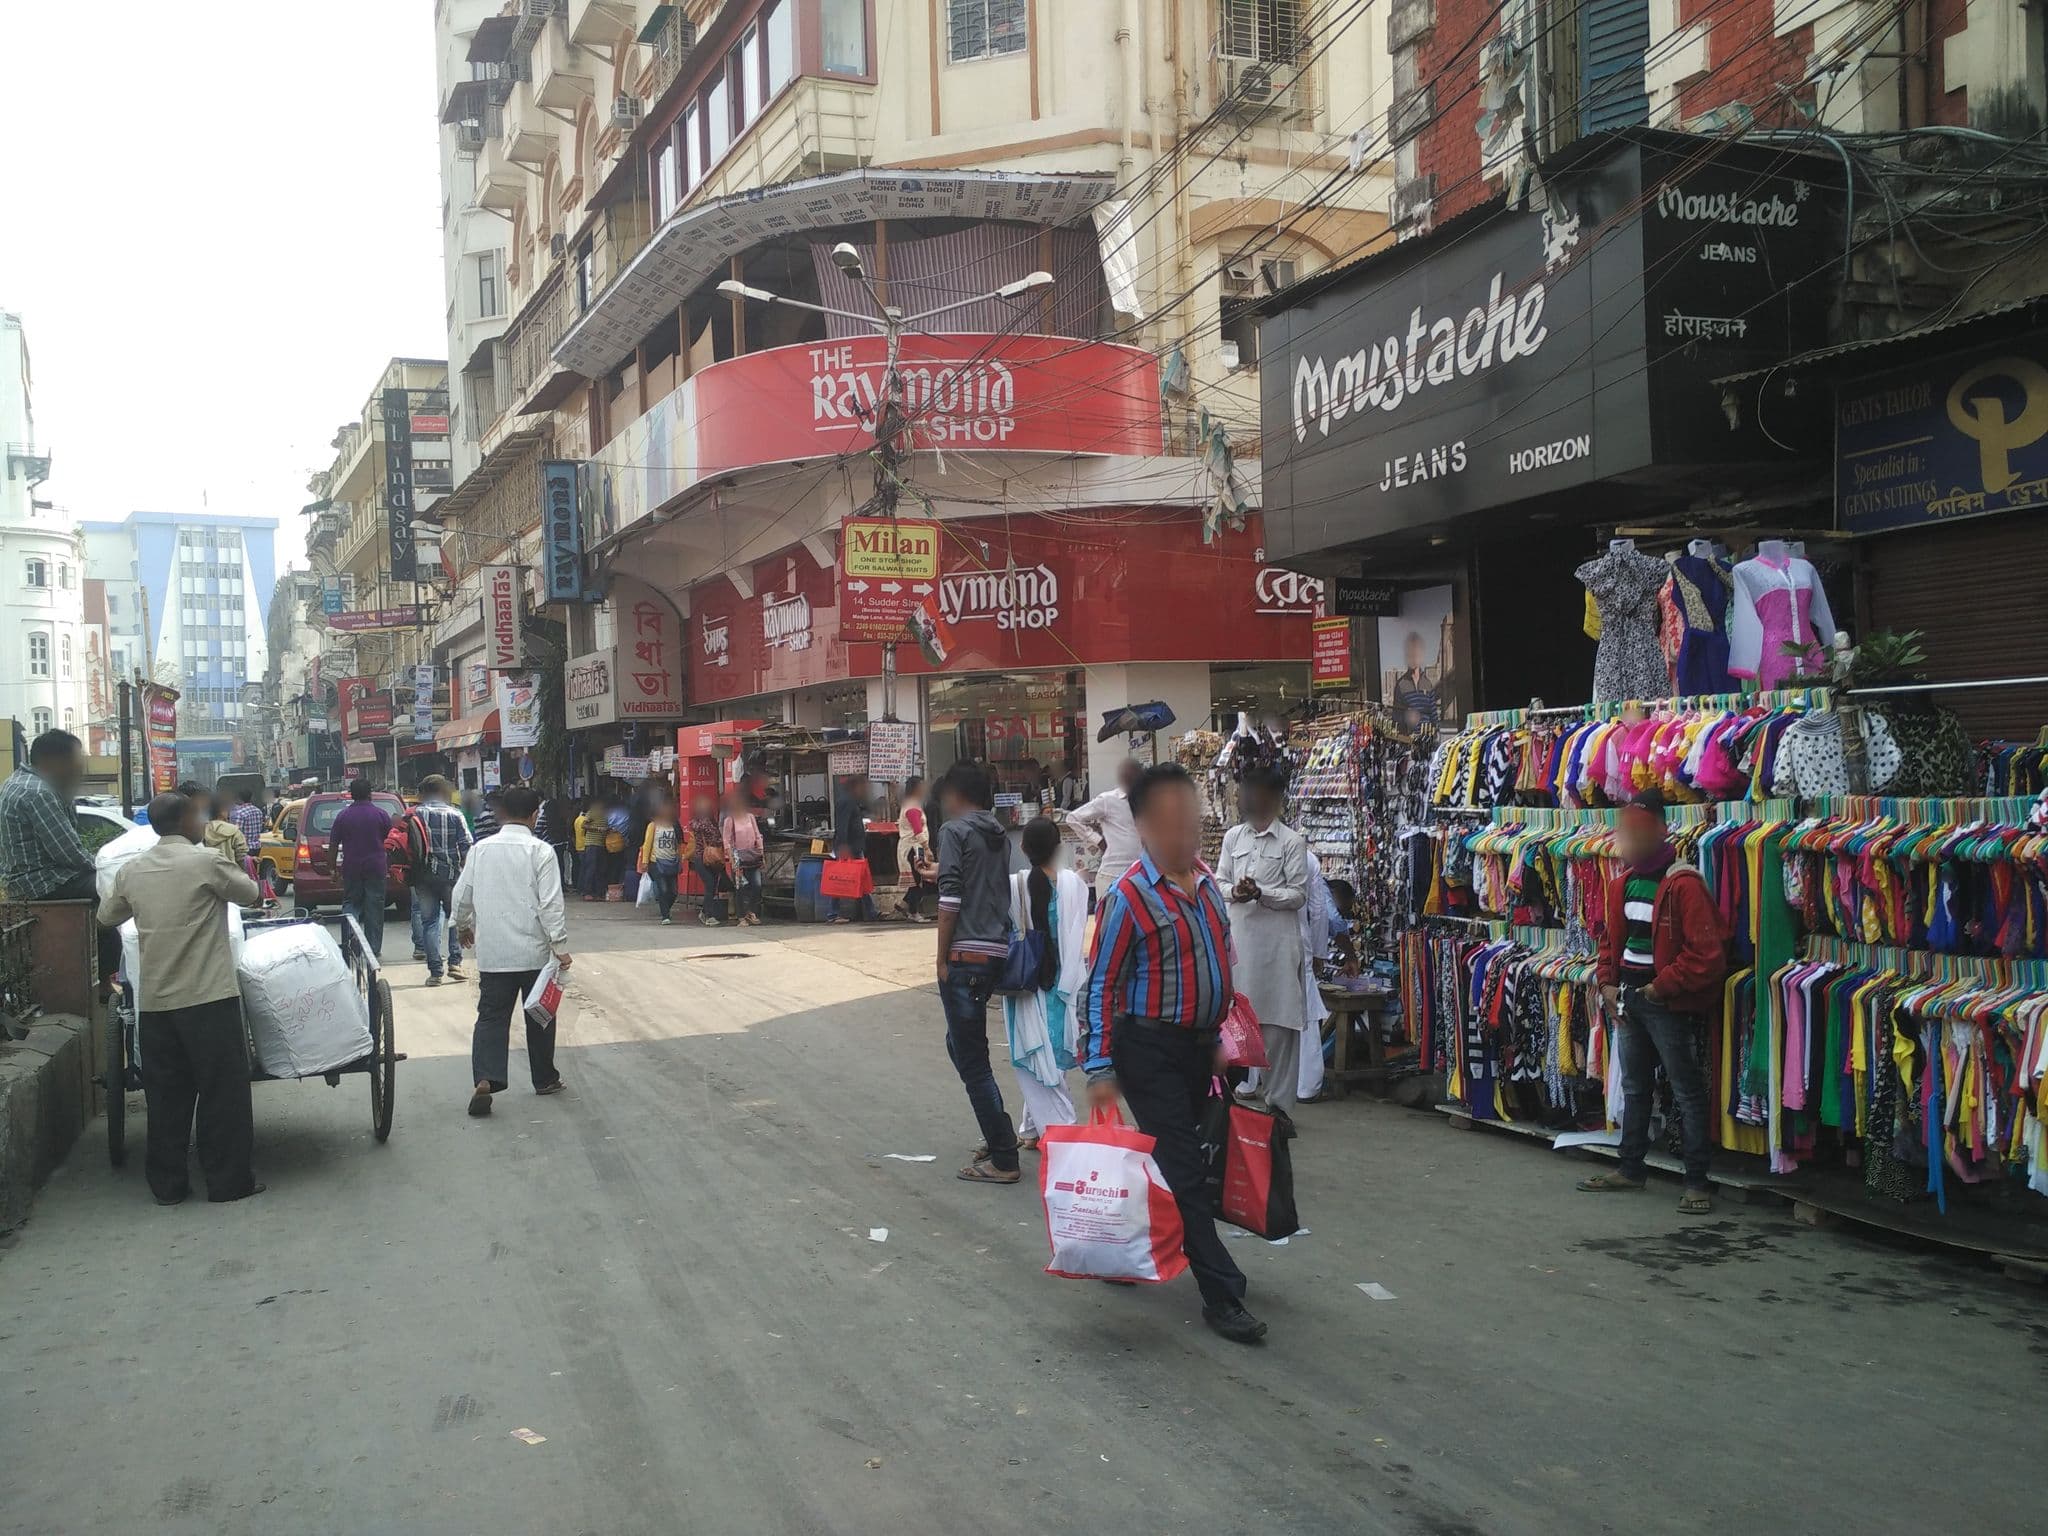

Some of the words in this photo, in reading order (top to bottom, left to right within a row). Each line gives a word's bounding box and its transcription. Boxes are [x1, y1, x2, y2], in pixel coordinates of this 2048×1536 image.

[1657, 182, 1799, 228] Moustache
[1699, 243, 1758, 264] JEANS
[809, 345, 854, 373] THE
[1293, 272, 1548, 444] Moustache
[809, 357, 1015, 433] Raymond
[931, 415, 1016, 442] SHOP
[1841, 399, 1882, 427] GENTS
[1379, 441, 1468, 492] JEANS
[1509, 434, 1591, 475] HORIZON
[1853, 455, 1905, 490] Specialist
[391, 424, 410, 560] Lindsay
[1843, 491, 1882, 517] GENTS
[1883, 480, 1938, 508] SUITINGS
[852, 530, 930, 556] Milan
[492, 569, 515, 666] Vidhaata's
[868, 597, 899, 607] Sudder
[997, 607, 1059, 630] SHOP
[623, 701, 681, 713] Vidhaata's
[986, 712, 1070, 741] SALE
